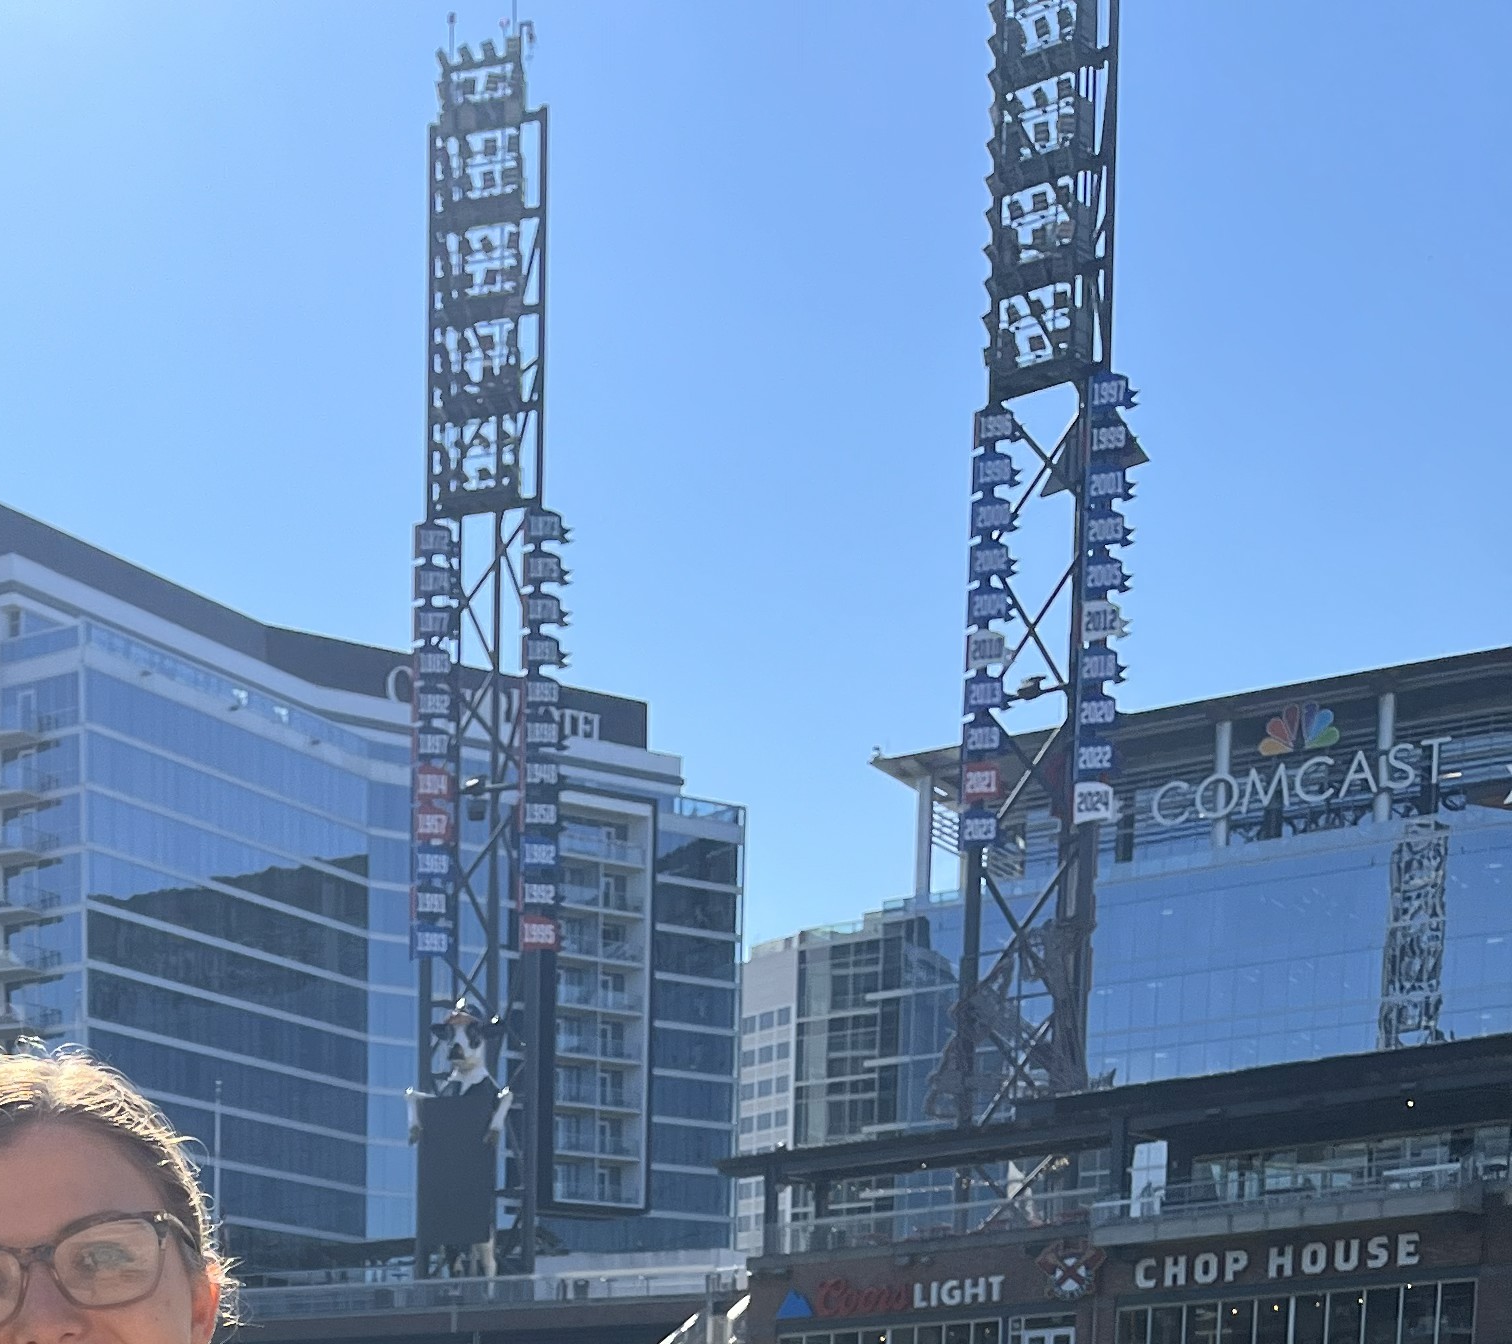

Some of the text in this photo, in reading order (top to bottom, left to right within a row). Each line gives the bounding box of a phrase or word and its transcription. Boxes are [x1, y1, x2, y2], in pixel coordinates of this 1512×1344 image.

[1093, 380, 1126, 405] 1997
[1092, 426, 1125, 450] 1999
[1090, 471, 1123, 496] 2001
[1089, 517, 1123, 542] 2003
[1088, 563, 1121, 588] 2005
[1085, 609, 1117, 631] 2012
[1082, 654, 1115, 678] 2018
[1080, 700, 1114, 724] 2020
[1079, 745, 1112, 769] 2022
[966, 770, 996, 793] 2021
[1151, 736, 1453, 826] COMCAST
[1134, 1249, 1248, 1290] CHOP
[1266, 1231, 1421, 1279] HOUSE
[815, 1273, 1006, 1317] Coors LIGHT
